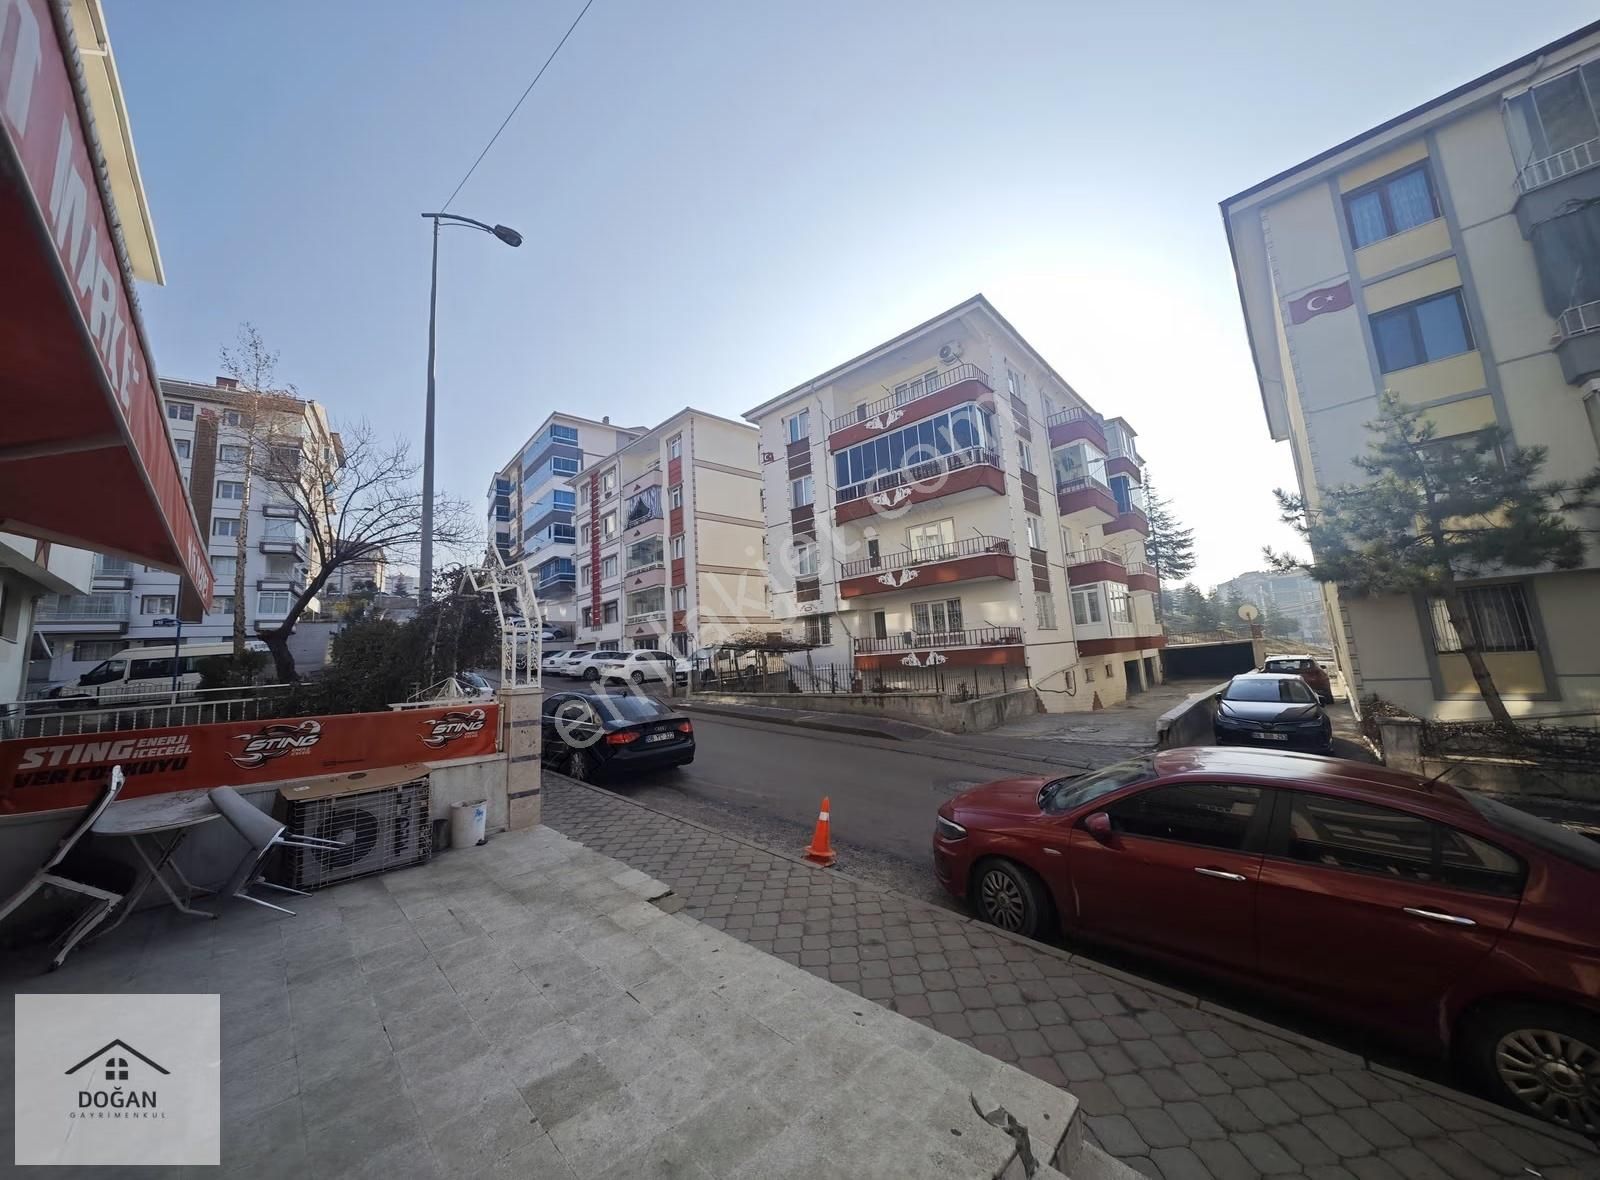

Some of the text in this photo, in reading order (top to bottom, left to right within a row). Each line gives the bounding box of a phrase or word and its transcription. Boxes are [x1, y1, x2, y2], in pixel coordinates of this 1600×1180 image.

[432, 720, 485, 735] STING
[245, 734, 320, 752] STING
[18, 739, 137, 770] STING
